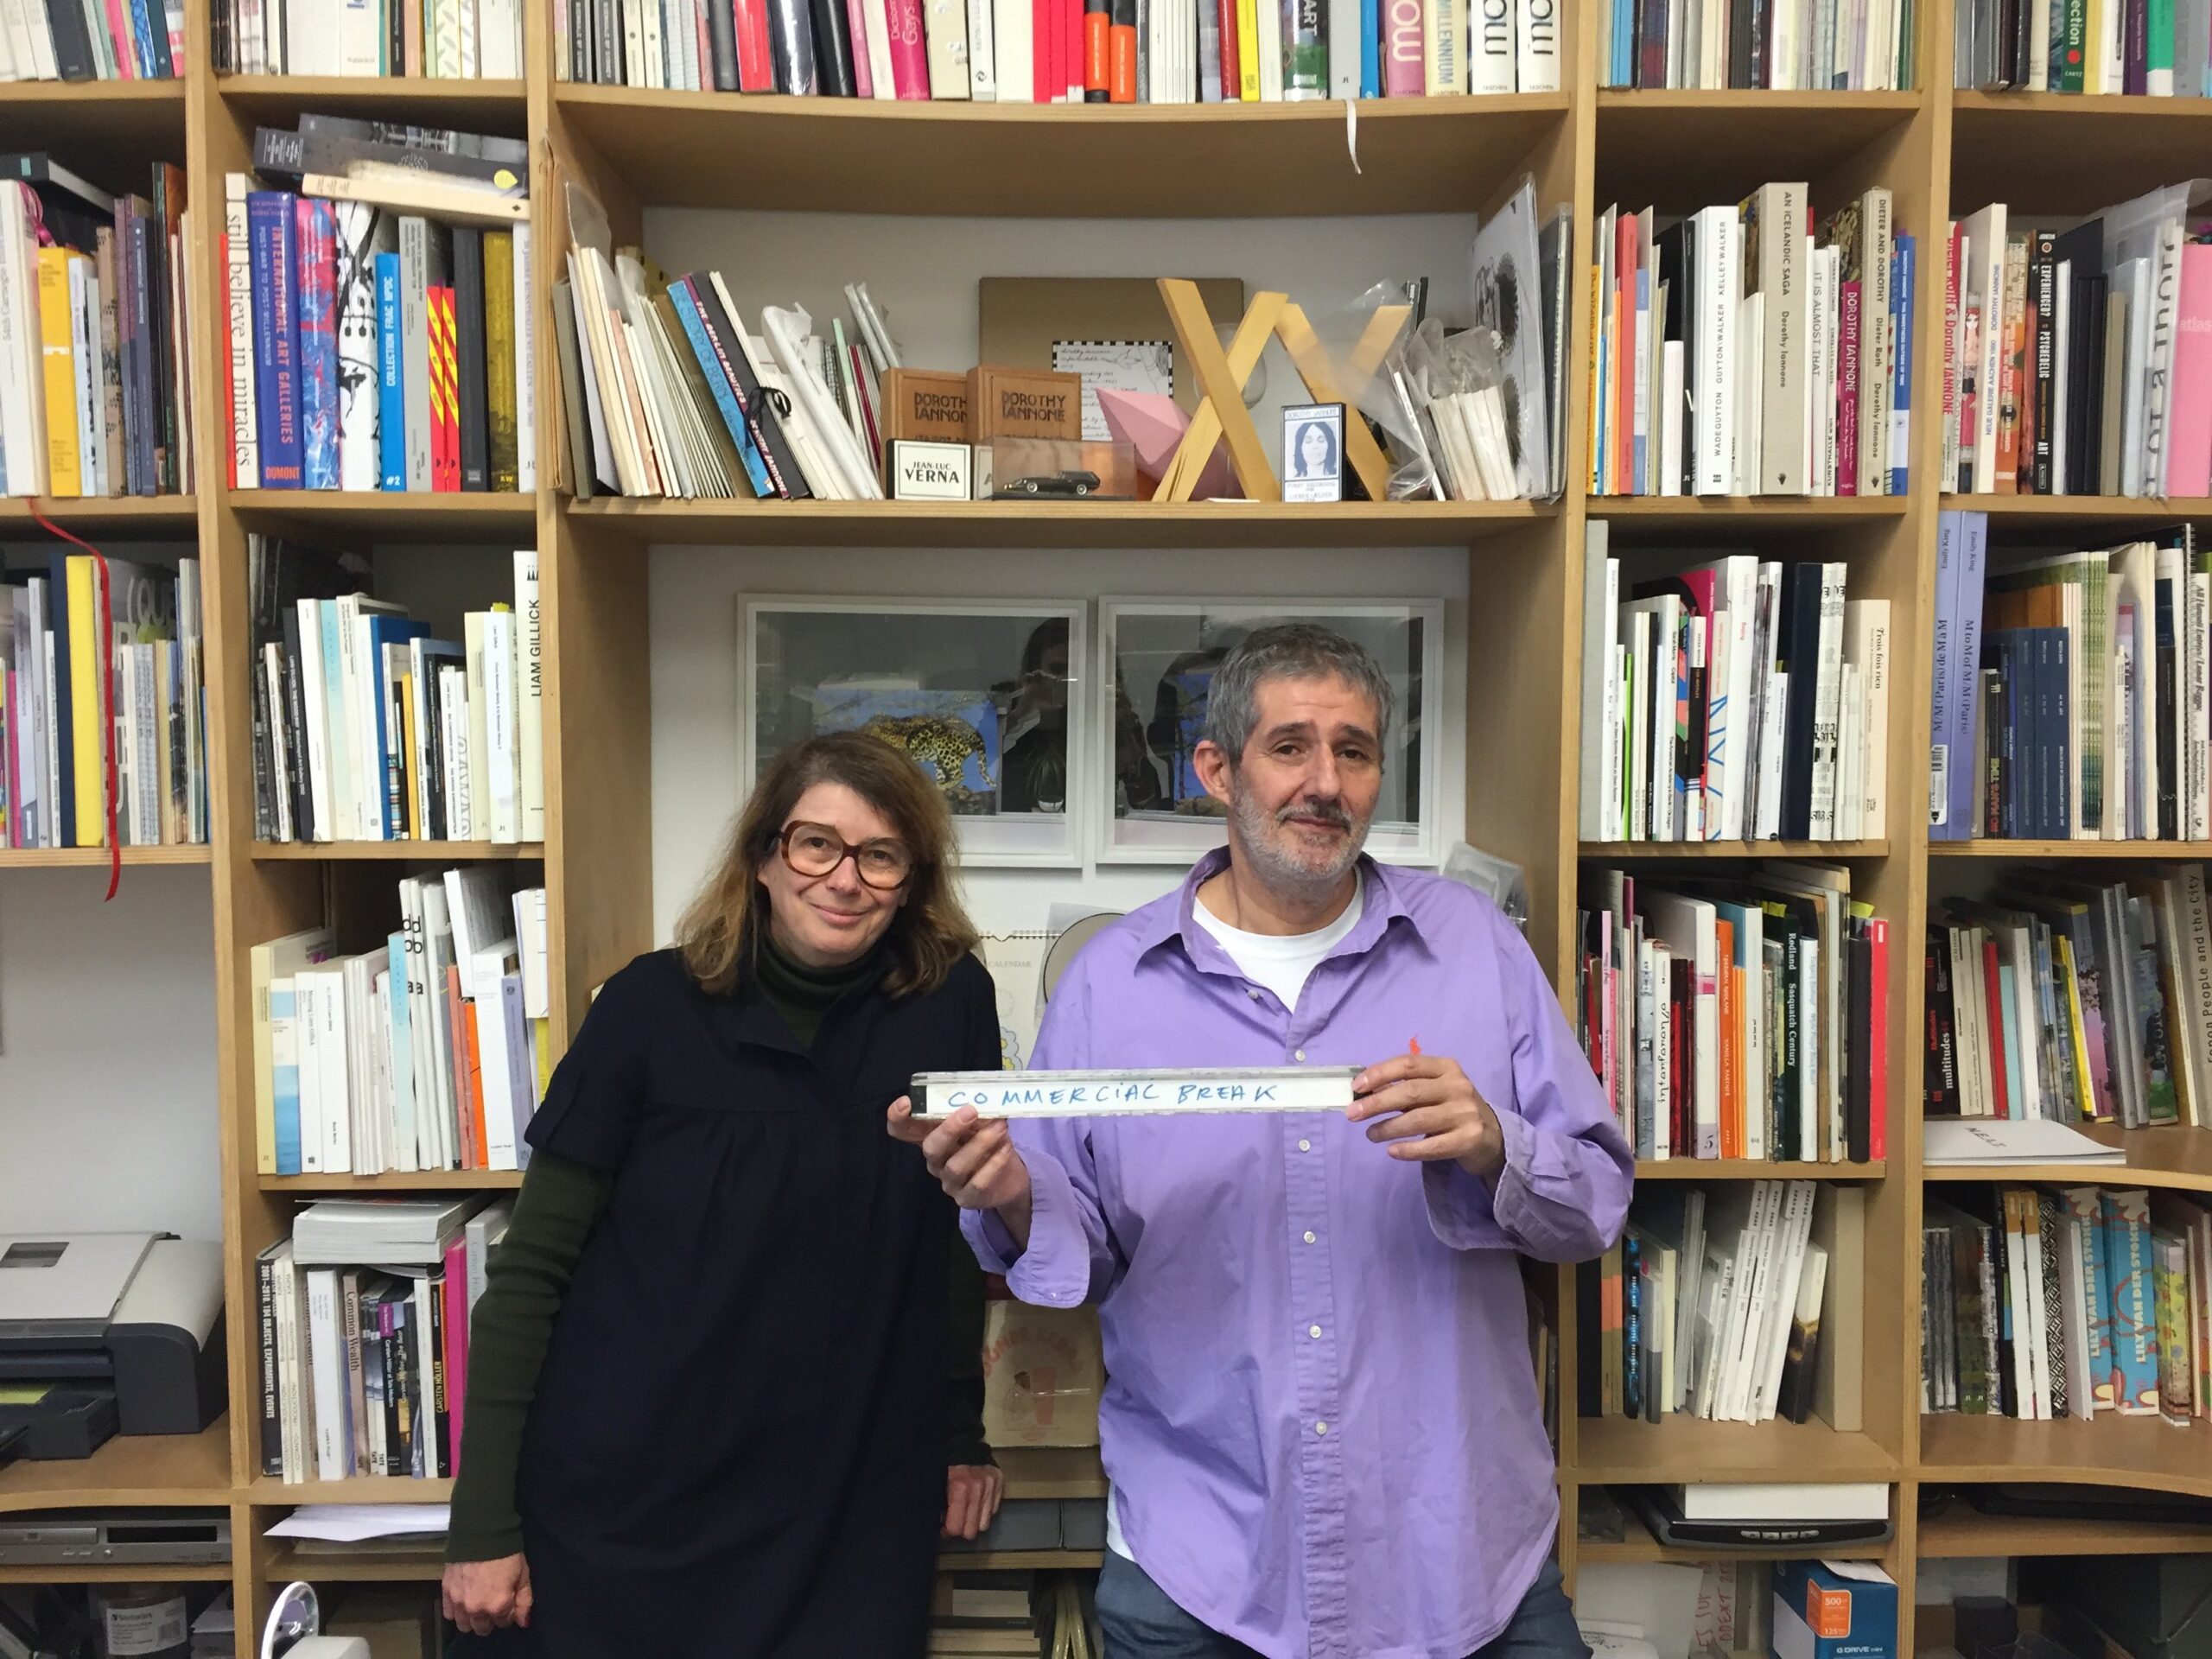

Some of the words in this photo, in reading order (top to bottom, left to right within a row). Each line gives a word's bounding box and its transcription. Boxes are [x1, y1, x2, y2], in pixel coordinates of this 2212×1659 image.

[902, 6, 921, 45] Gays
[1303, 0, 1317, 36] ART
[1783, 191, 1792, 207] AN
[1877, 200, 1886, 231] DIETER
[228, 214, 249, 251] still
[1783, 211, 1791, 264] ICELANDIC
[1876, 233, 1885, 254] AND
[271, 226, 288, 332] INTERNATIONAL
[1782, 267, 1791, 296] SAGA
[1813, 272, 1821, 283] IT
[1813, 286, 1821, 296] IS
[1875, 257, 1885, 303] DOROTHY
[1992, 264, 2000, 295] IANNONE
[2040, 264, 2052, 317] EXPERIENCED?
[229, 263, 251, 338] believe
[1990, 297, 1999, 331] DOROTHY
[385, 307, 395, 330] FRAC
[1779, 310, 1789, 347] Dorothy
[1812, 301, 1821, 344] ALMOST
[1847, 292, 1858, 340] DOROTHY
[2179, 316, 2211, 330] atlas
[1874, 317, 1884, 345] Dieter
[1942, 321, 1956, 363] Dorothy
[233, 347, 252, 367] in
[276, 338, 289, 364] ART
[386, 334, 396, 387] COLLECTION
[696, 301, 709, 320] THE
[706, 324, 725, 359] BERLIN
[722, 361, 747, 404] BEAUTIES
[1812, 350, 1821, 377] THAT
[1874, 347, 1883, 368] Roth
[2038, 331, 2050, 378] PSYCHEDELIC
[1779, 351, 1788, 388] Iannone
[1845, 345, 1856, 392] IANNONE
[914, 392, 968, 408] DOROTH
[1001, 391, 1066, 406] DOROTHY
[1872, 384, 1882, 419] Dorothy
[1942, 367, 1955, 416] IANNONE
[277, 371, 293, 443] GALLERIES
[915, 408, 968, 423] IANNON
[1001, 407, 1066, 423] IANNONE
[234, 378, 257, 467] miracles
[1872, 422, 1881, 459] Iannone
[2037, 442, 2049, 456] ART
[266, 467, 300, 480] DUMONT
[905, 469, 960, 484] VERNA
[912, 461, 951, 471] JEAN-LUC
[1942, 528, 1951, 547] King
[1969, 531, 1978, 551] Emily
[1941, 548, 1949, 569] Emily
[1967, 553, 1977, 572] King
[529, 600, 541, 657] GILLICK
[1875, 627, 1885, 651] Trois
[1938, 620, 1948, 631] M
[1965, 620, 1974, 631] M
[1965, 633, 1974, 643] to
[1936, 653, 1946, 665] de
[1937, 641, 1946, 652] M
[1964, 645, 1974, 655] M
[1874, 653, 1884, 669] fois
[1963, 656, 1973, 669] of
[530, 661, 542, 697] LIAM
[1874, 671, 1883, 690] rien
[1934, 668, 1947, 703] (Paris)
[1962, 671, 1971, 697] M/M
[1934, 705, 1943, 731] M/M
[1961, 702, 1971, 734] (Paris)
[2187, 874, 2200, 903] City
[2192, 907, 2203, 932] the
[1788, 933, 1796, 969] Rødland
[2195, 937, 2206, 962] and
[988, 960, 1032, 969] CALENDAR
[1787, 983, 1797, 1028] Sasquatch
[2198, 967, 2212, 1016] People
[1787, 1031, 1797, 1067] Century
[1940, 1033, 1954, 1090] multitudes
[1177, 1084, 1280, 1105] BREAK
[2085, 1265, 2095, 1293] DER
[2131, 1269, 2142, 1298] DER
[346, 1291, 357, 1336] Common
[2087, 1296, 2097, 1326] VAN
[2133, 1301, 2144, 1331] VAN
[348, 1338, 359, 1372] Wealth
[2089, 1328, 2101, 1356] LILY
[2135, 1332, 2146, 1363] LILY
[433, 1361, 442, 1385] HÖLLER
[265, 1395, 275, 1419] EVENTS
[435, 1385, 443, 1413] CARSTEN
[1824, 1598, 1842, 1606] 500
